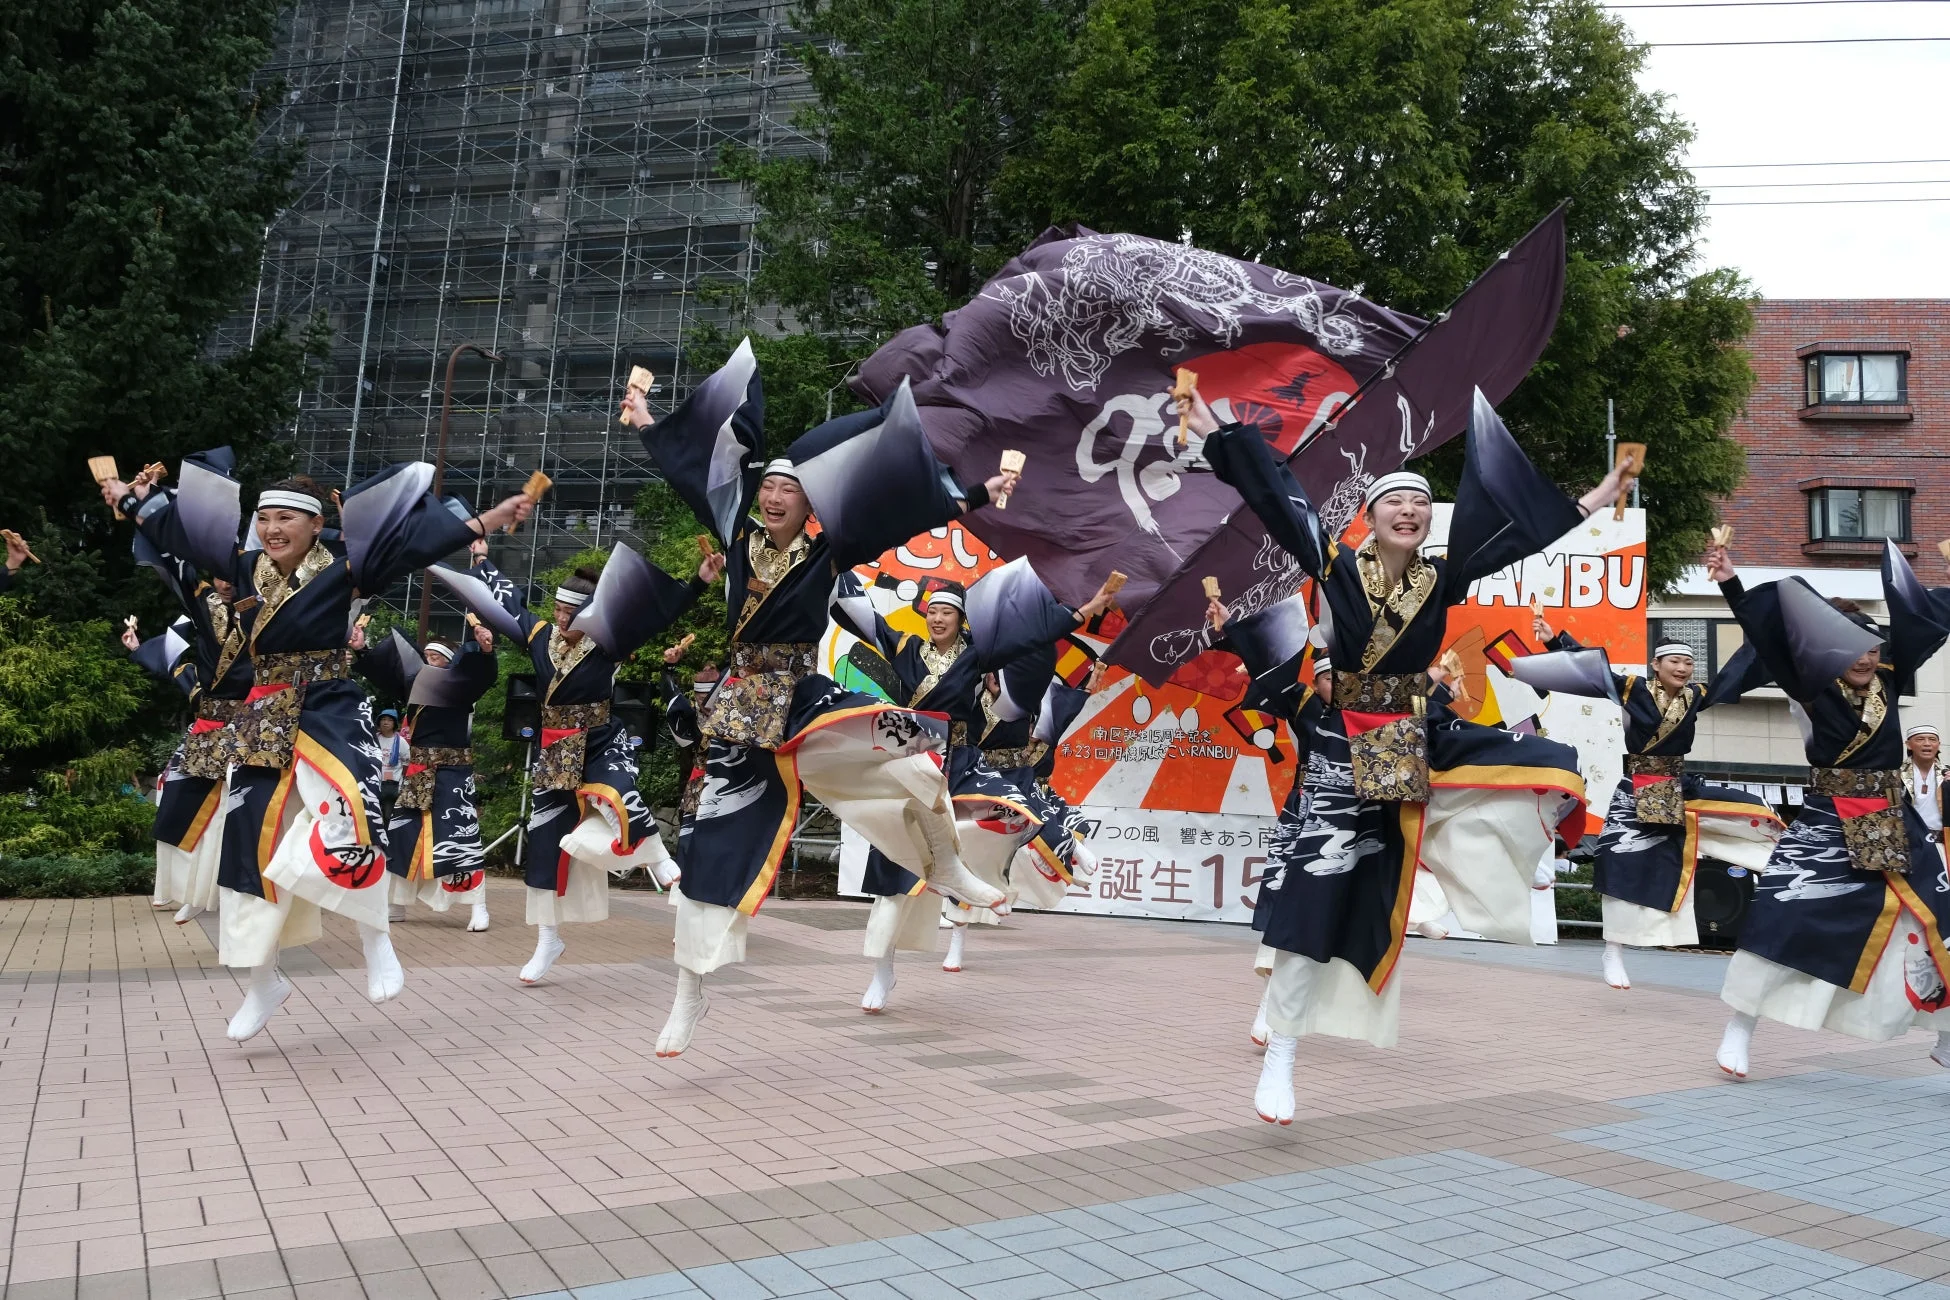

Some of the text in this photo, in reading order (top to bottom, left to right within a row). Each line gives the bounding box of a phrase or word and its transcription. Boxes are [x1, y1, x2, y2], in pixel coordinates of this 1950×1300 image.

[1424, 545, 1645, 609] ANBU
[1093, 726, 1212, 744] 南区誕生15周年記念
